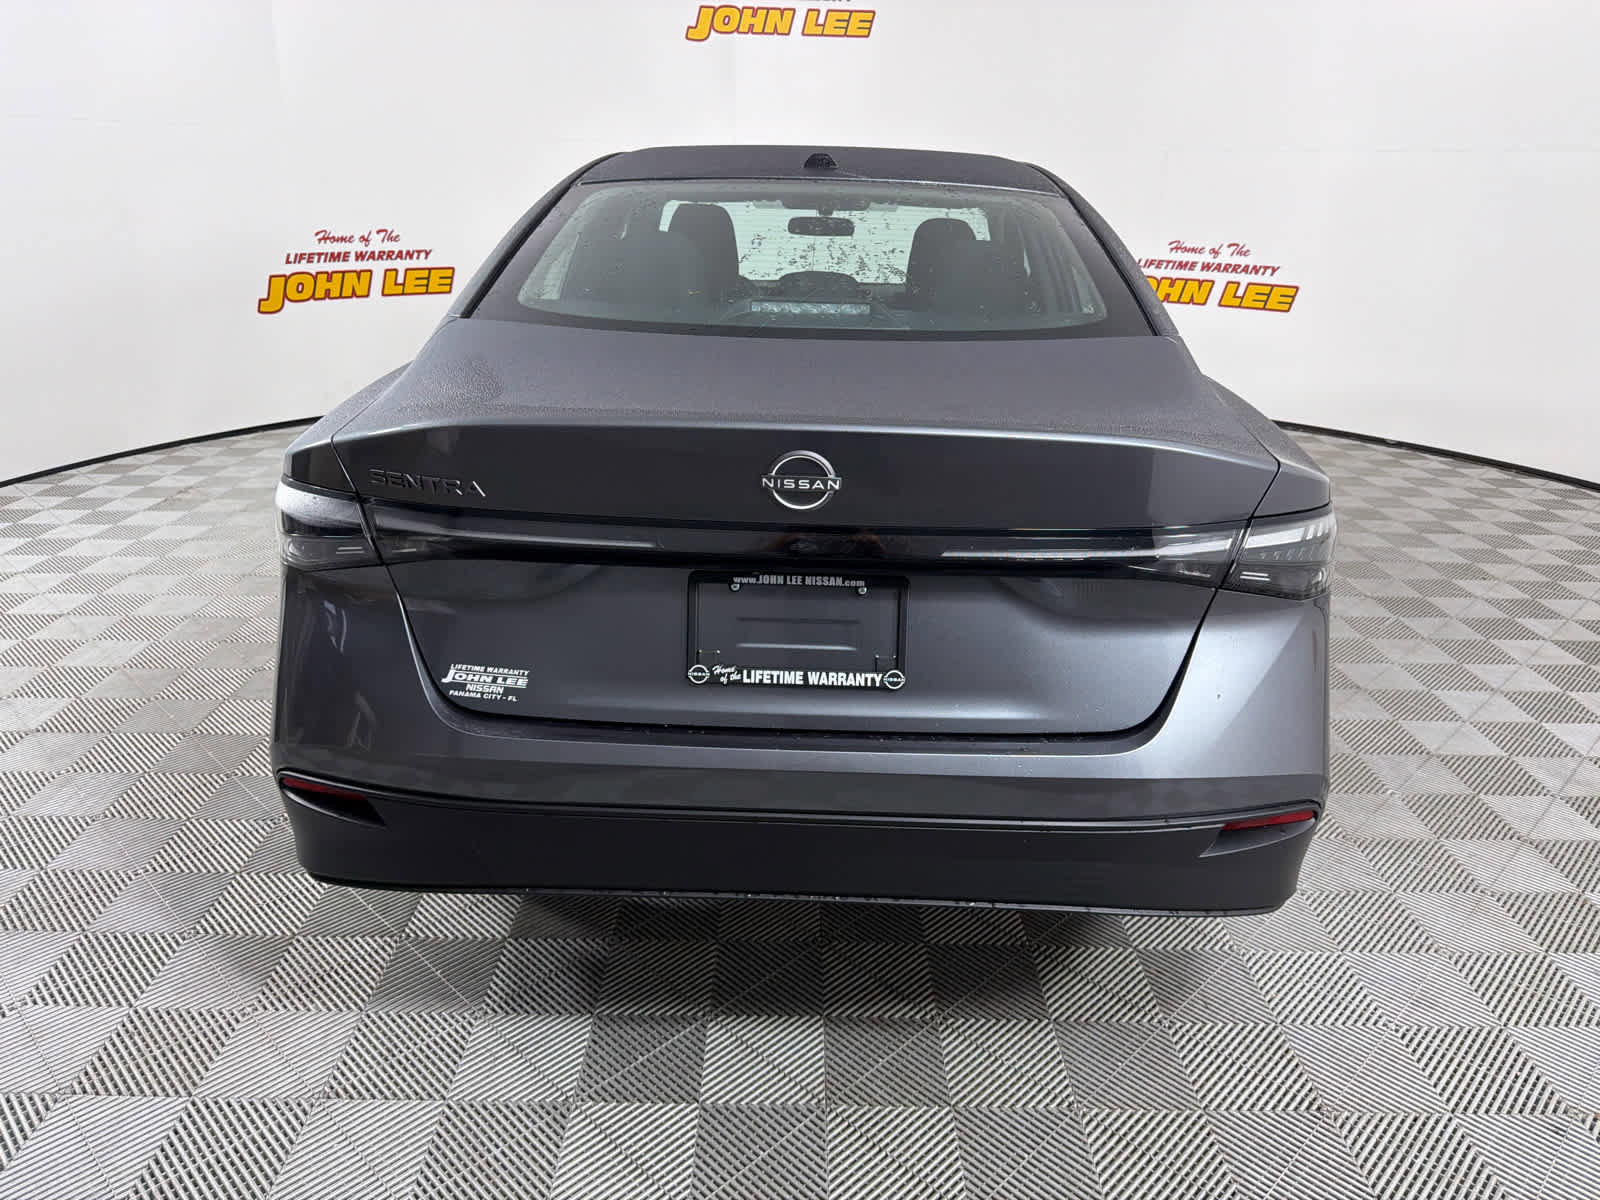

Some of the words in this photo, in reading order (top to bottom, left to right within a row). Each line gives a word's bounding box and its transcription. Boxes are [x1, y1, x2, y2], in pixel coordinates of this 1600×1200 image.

[685, 5, 795, 42] JOHN
[801, 9, 876, 37] LEE
[314, 229, 355, 244] Home
[358, 230, 373, 247] of
[376, 229, 401, 244] The
[285, 251, 350, 265] LIFETIME
[354, 249, 433, 263] WARRANTY
[1168, 240, 1206, 254] Home
[1208, 244, 1223, 258] of
[1227, 243, 1252, 257] The
[1200, 261, 1281, 277] WARRANTY
[257, 269, 373, 314] JOHN
[381, 267, 455, 297] LEE
[1217, 281, 1300, 313] LEE
[369, 468, 486, 497] SENTRA
[762, 477, 840, 490] NISSAN
[786, 575, 803, 585] LEE
[441, 669, 494, 684] JOHN
[496, 677, 529, 688] LEE
[450, 664, 486, 672] LIFETIME
[486, 667, 530, 676] WARRANTY
[742, 669, 804, 685] LIFETIME
[807, 671, 883, 687] WARRANTY
[449, 690, 482, 698] PANAMA
[465, 683, 505, 694] NISSAN
